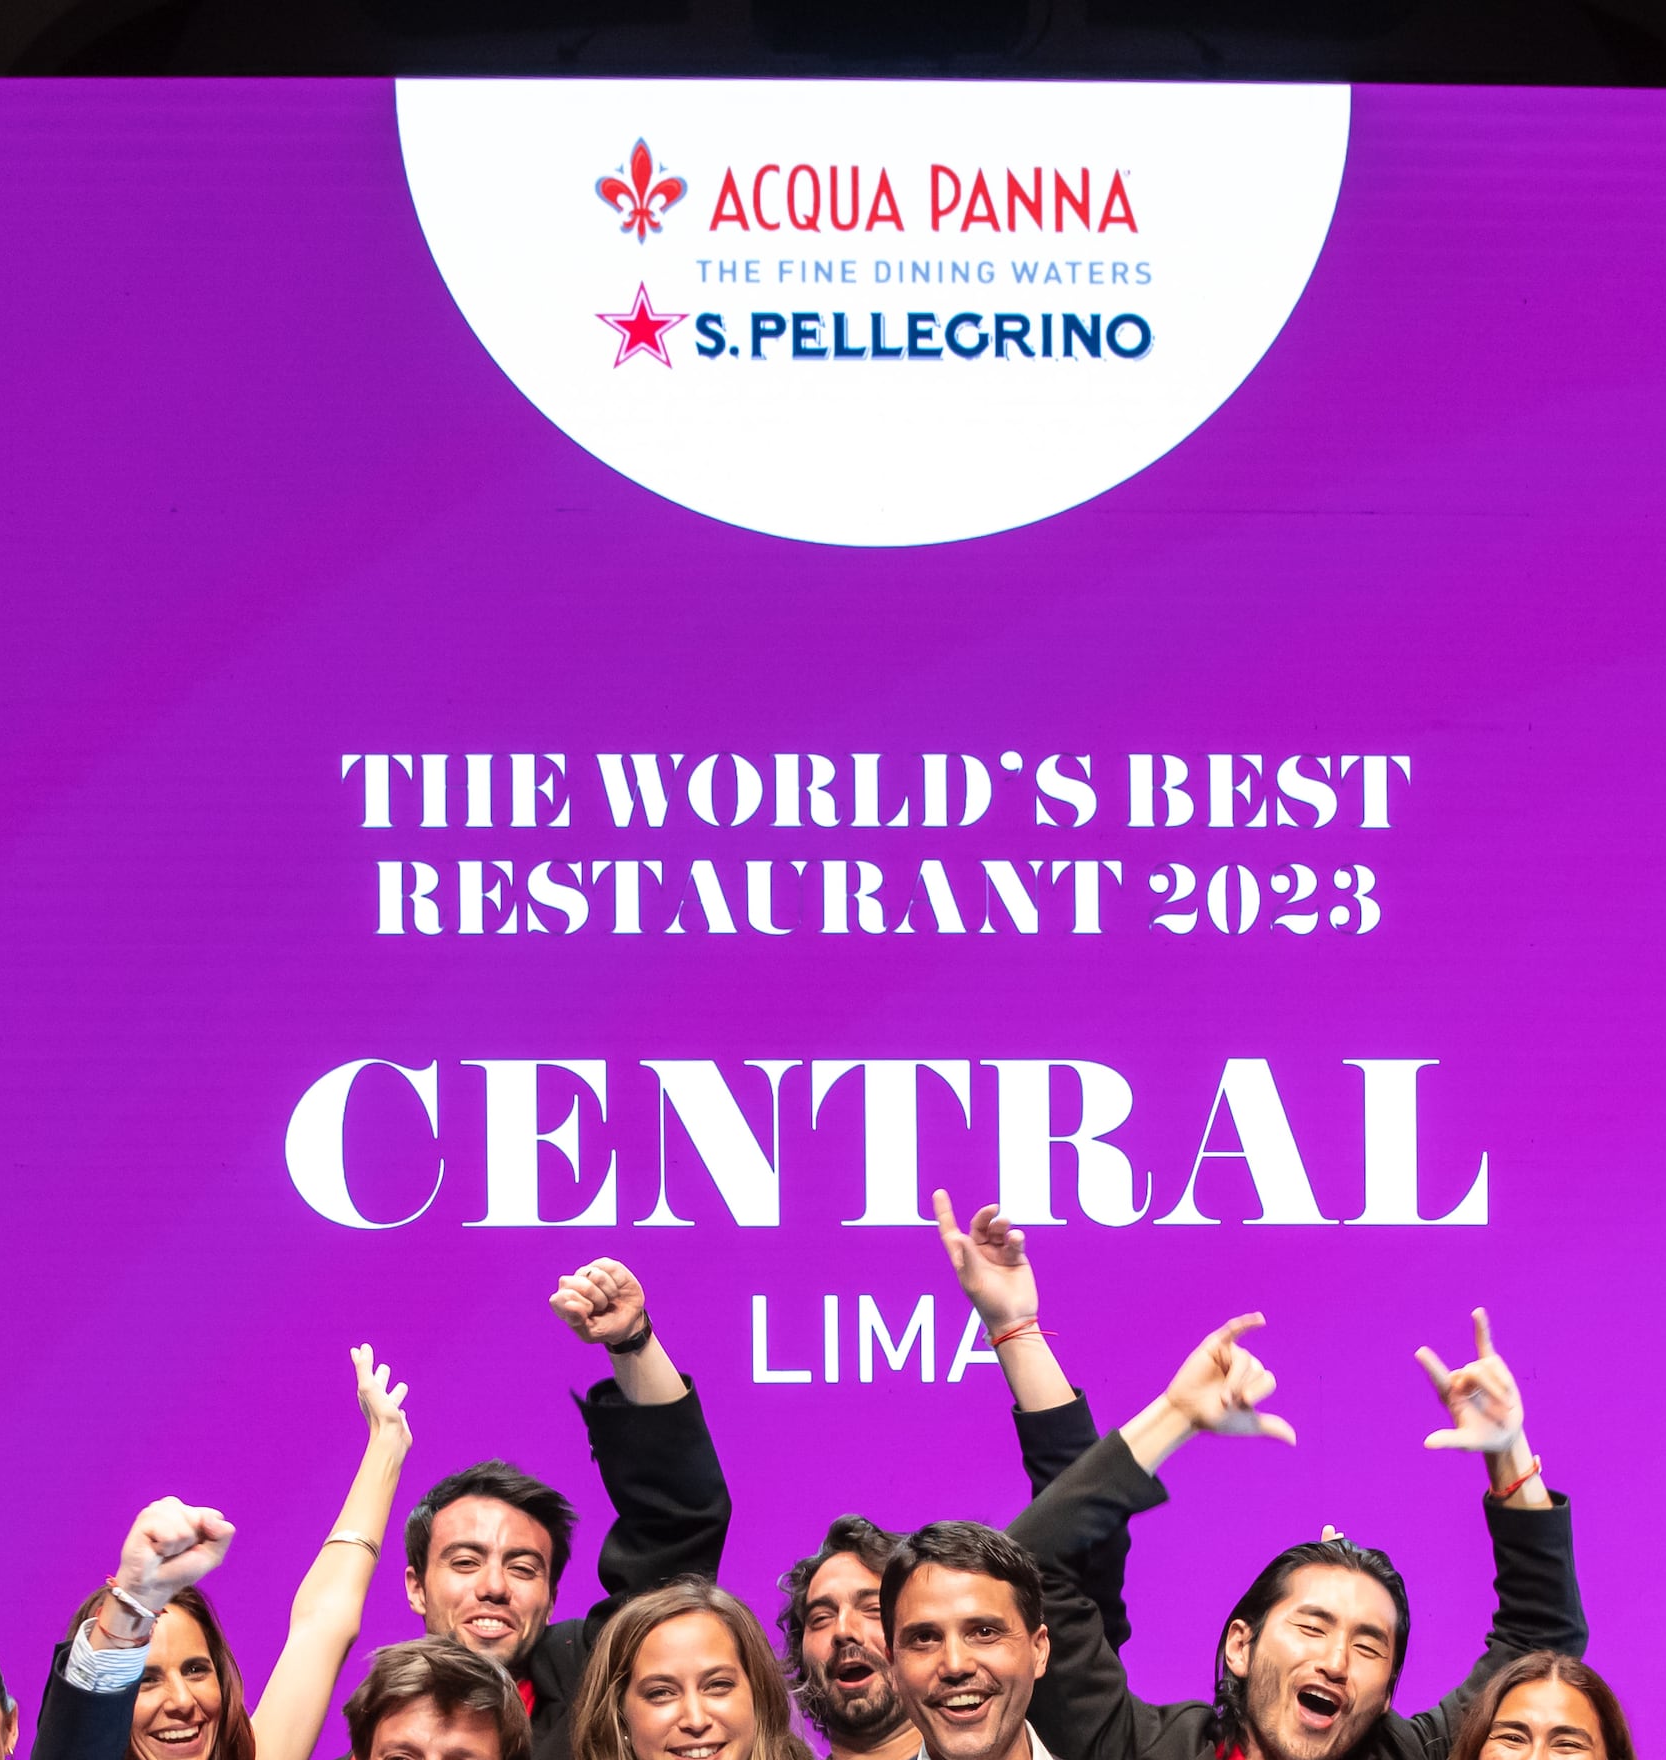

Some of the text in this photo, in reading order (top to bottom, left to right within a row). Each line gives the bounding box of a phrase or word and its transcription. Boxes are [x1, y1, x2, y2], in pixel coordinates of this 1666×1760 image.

[709, 164, 1139, 233] ACQUA PANNA
[697, 260, 1152, 285] THE FINE DINING WATERS
[342, 750, 1411, 829] THE WORLD'S BEST
[377, 860, 1382, 935] RESTAURANT 2023
[285, 1058, 1489, 1230] CENTRAL
